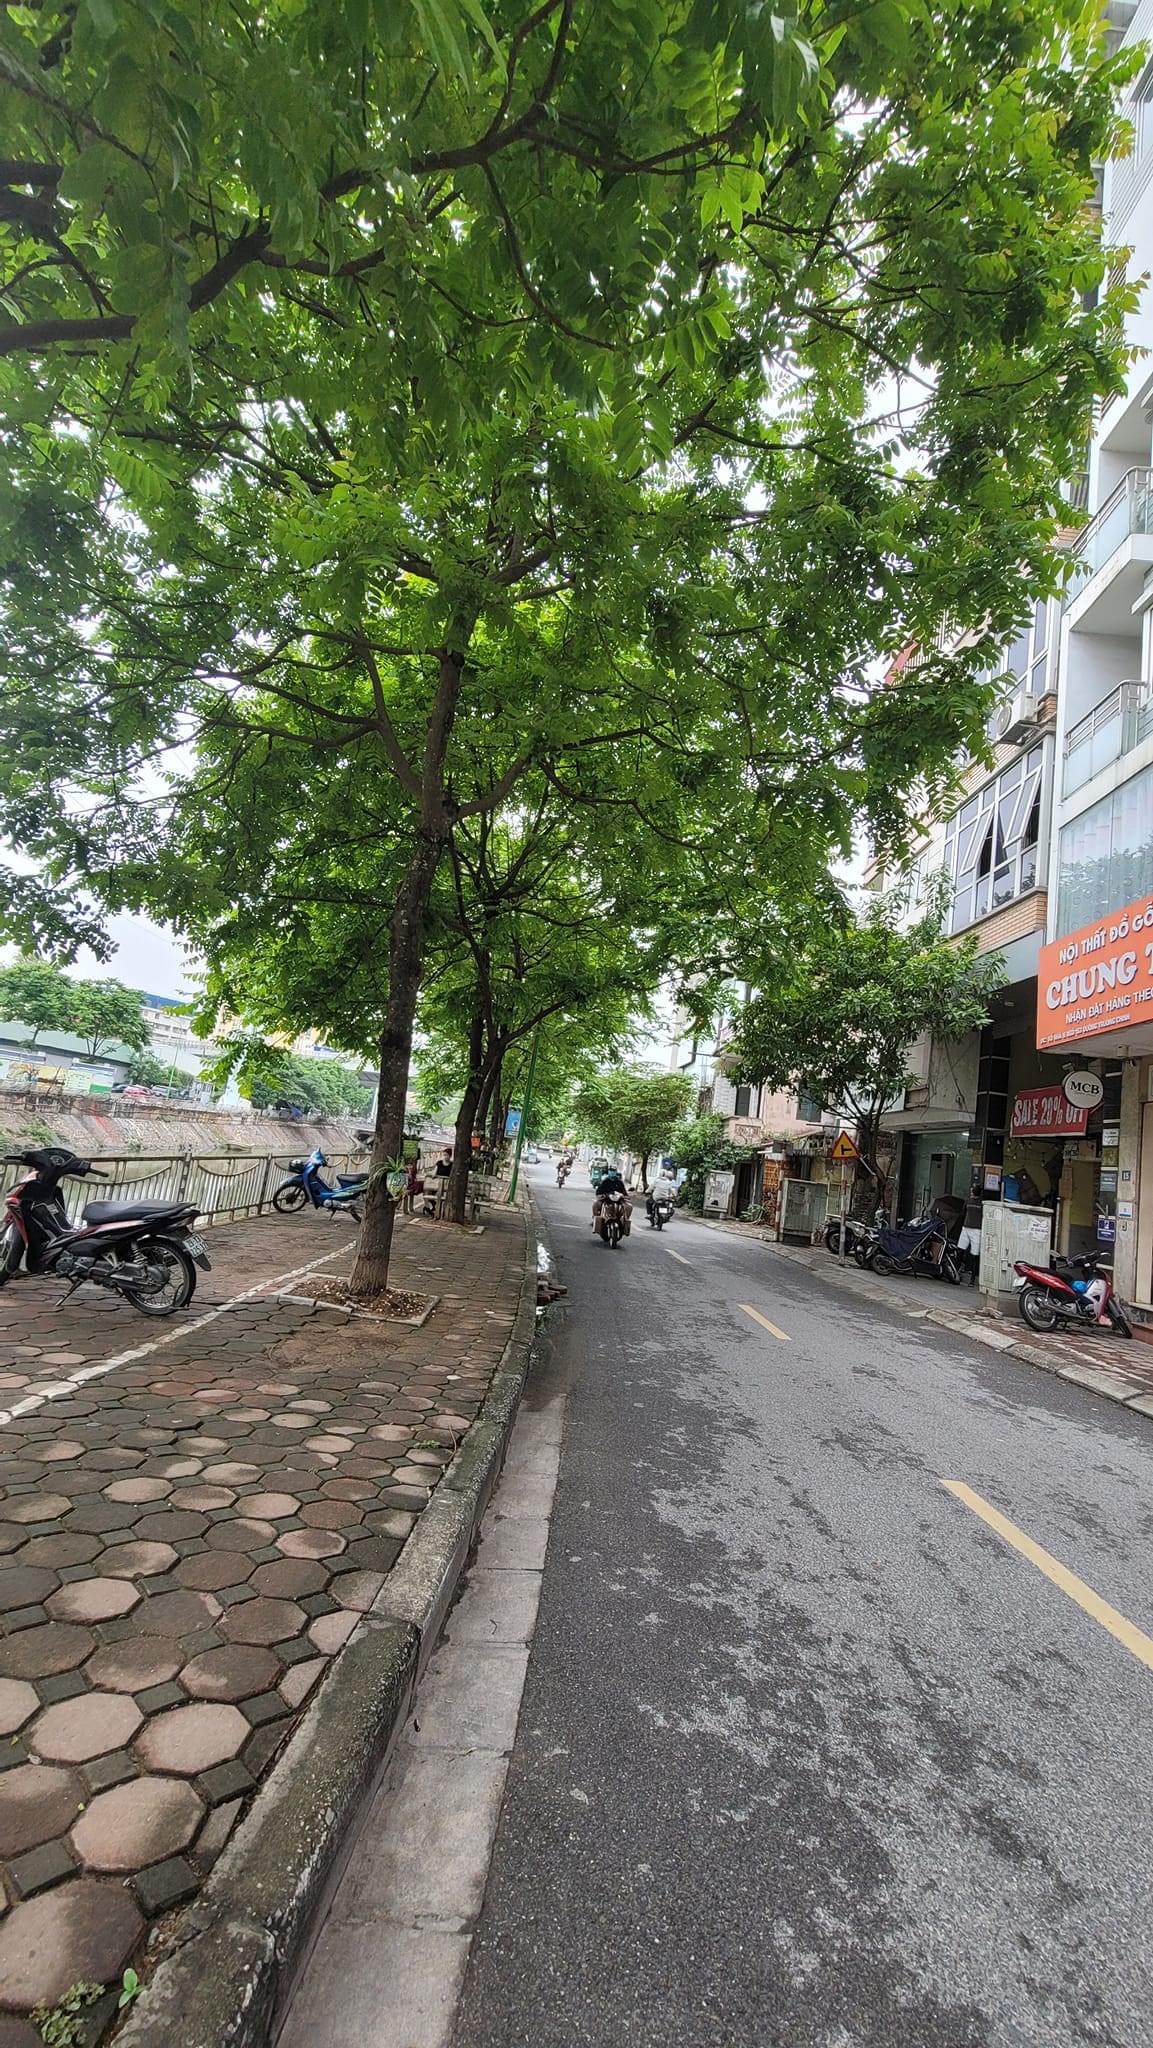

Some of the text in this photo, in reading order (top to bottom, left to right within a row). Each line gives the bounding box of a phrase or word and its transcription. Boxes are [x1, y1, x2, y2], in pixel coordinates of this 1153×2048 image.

[1059, 941, 1078, 965] NỘI
[1081, 927, 1107, 955] THẤT
[1109, 913, 1129, 942] ĐỒ
[1046, 951, 1138, 1009] CHUNG
[1065, 1008, 1087, 1025] NHẬN
[1105, 995, 1130, 1011] HÀNG
[1069, 1081, 1100, 1095] MCB
[1013, 1098, 1039, 1127] SALE
[1039, 1095, 1063, 1125] 20%
